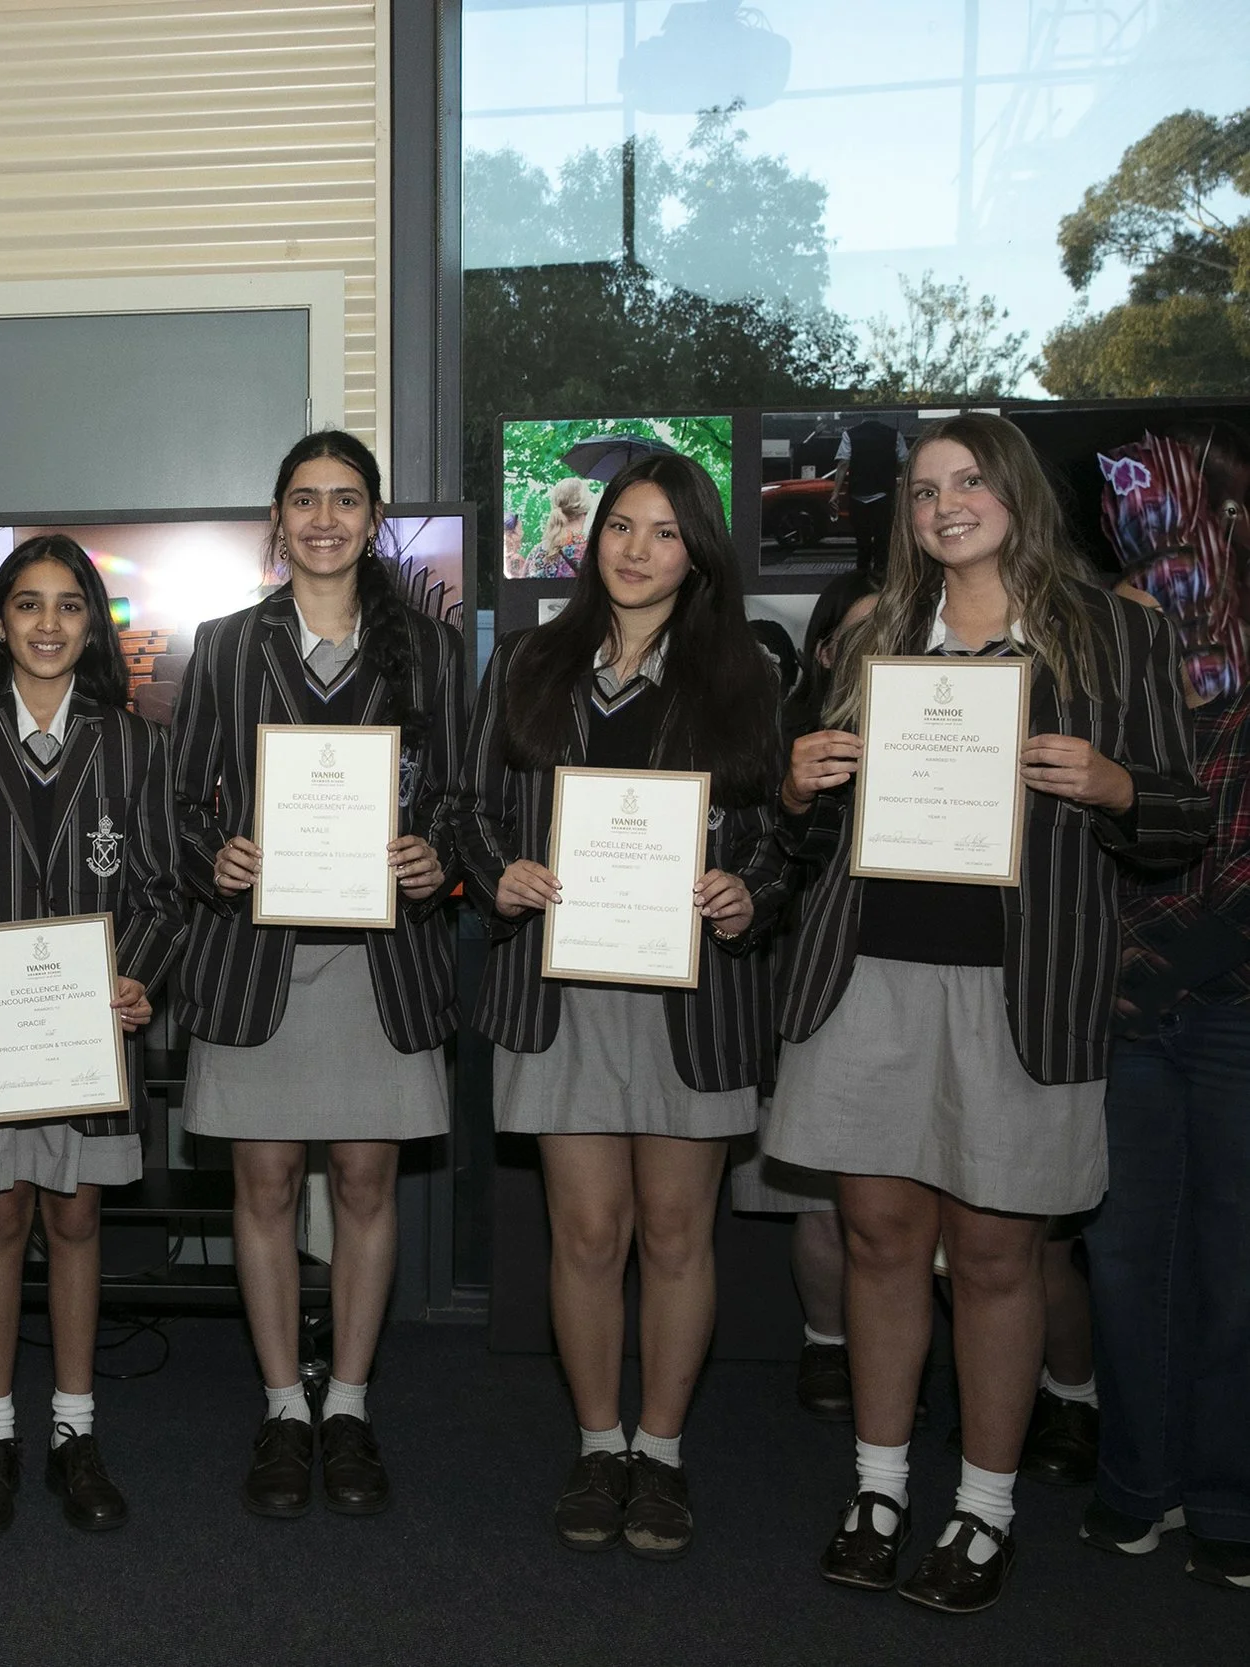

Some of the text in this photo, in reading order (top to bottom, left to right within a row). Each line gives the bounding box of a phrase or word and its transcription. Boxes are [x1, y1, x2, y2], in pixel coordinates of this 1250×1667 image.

[924, 708, 963, 716] IVANHOE
[901, 733, 979, 742] EXCELLENCE AND
[884, 742, 999, 753] ENCOURAGEMENT AWARD
[914, 797, 941, 805] DESIGN
[949, 799, 998, 807] TECHNOLOGY
[611, 817, 647, 826] IVANHOE
[590, 840, 662, 851] EXCELLENCE AND
[573, 849, 680, 862] ENCOURAGEMENT AWARD
[26, 962, 60, 972] IVANHOE
[10, 983, 78, 996] EXCELLENCE AND
[67, 990, 96, 999] AWARD
[17, 1019, 46, 1028] GRACIE
[30, 1042, 53, 1050] DESIGN
[60, 1038, 102, 1047] TECHNOLOGY
